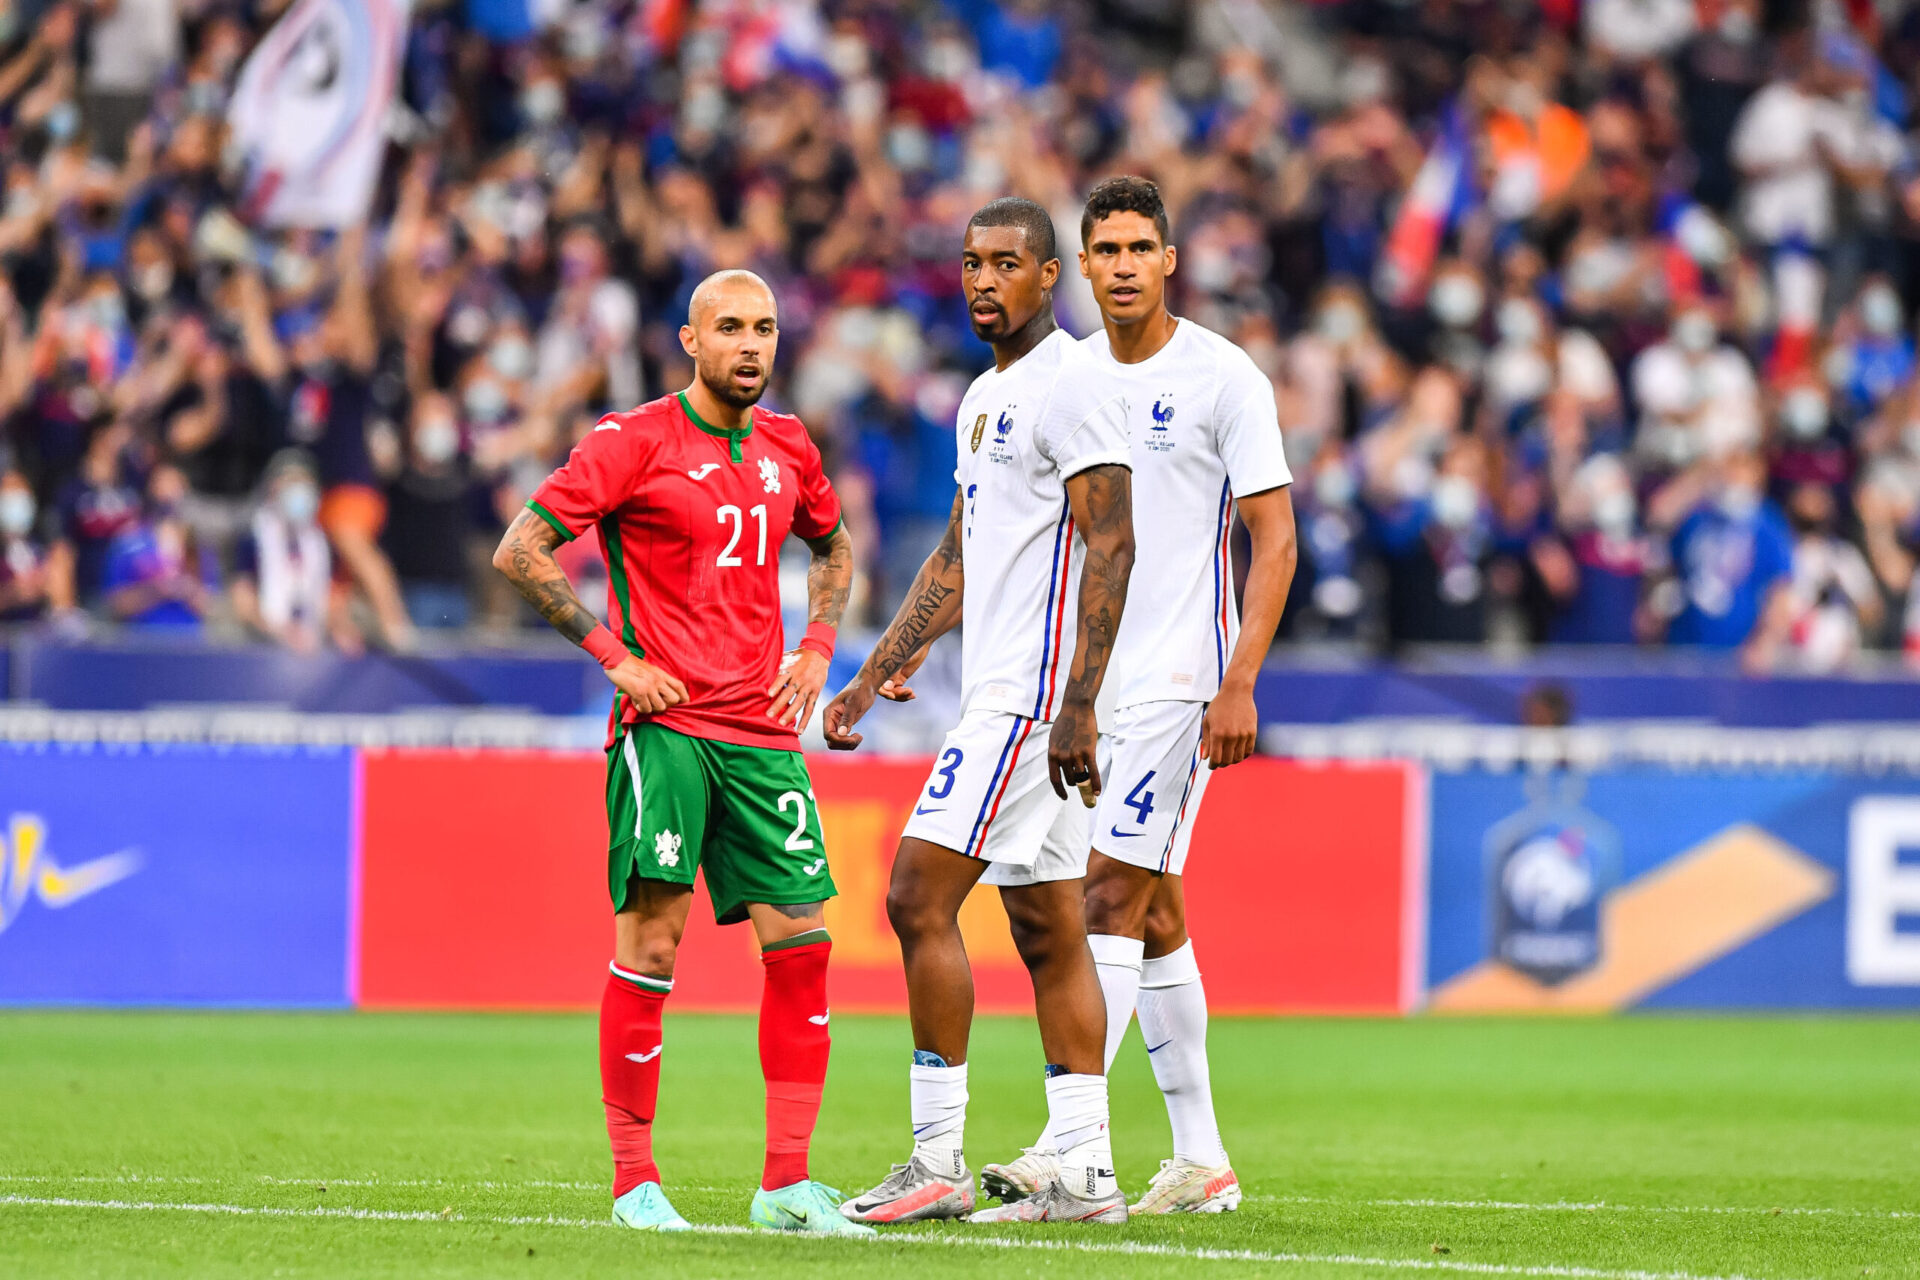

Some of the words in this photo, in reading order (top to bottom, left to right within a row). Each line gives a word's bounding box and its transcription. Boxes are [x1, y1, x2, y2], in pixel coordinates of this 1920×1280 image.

[716, 504, 767, 567] 21
[929, 748, 964, 799] 3
[1124, 770, 1157, 825] 4
